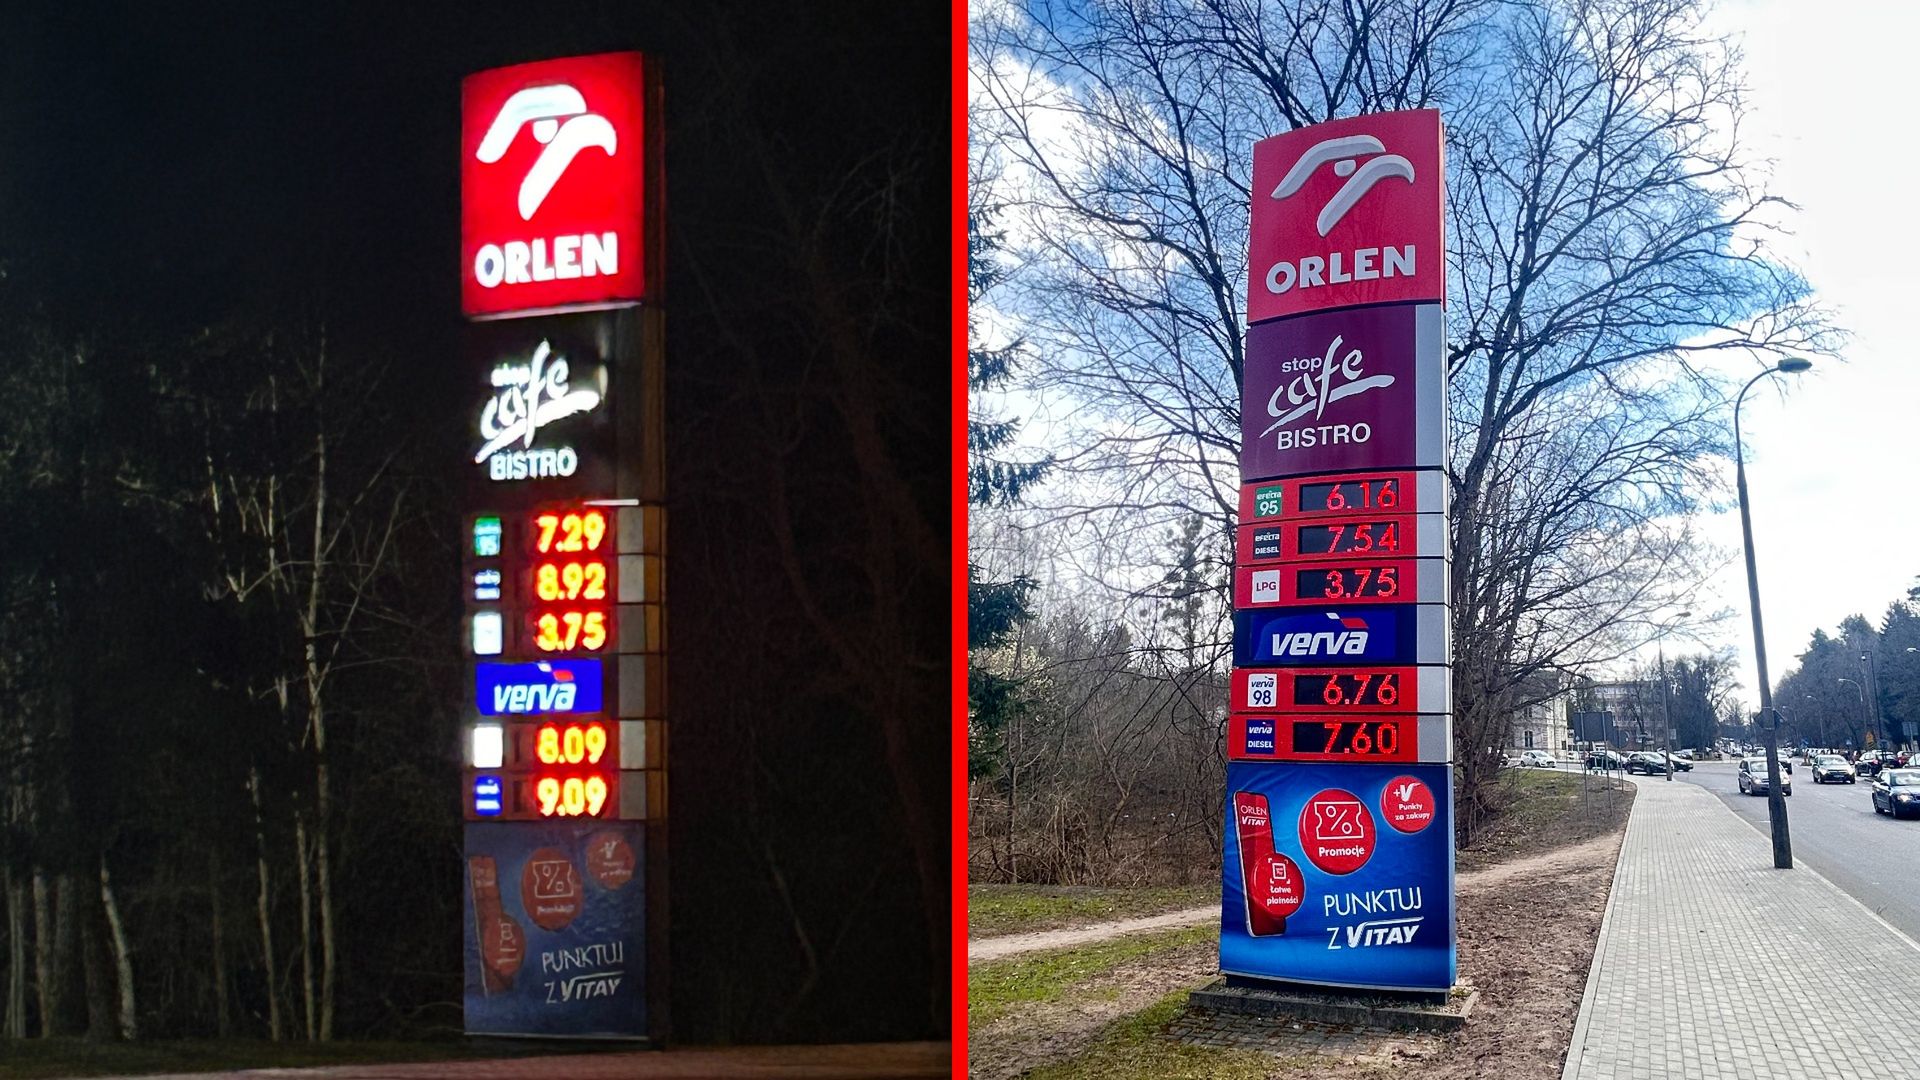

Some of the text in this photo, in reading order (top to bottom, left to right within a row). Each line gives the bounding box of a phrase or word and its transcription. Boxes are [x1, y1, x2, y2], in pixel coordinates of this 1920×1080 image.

[475, 231, 618, 288] ORLEN
[1265, 244, 1416, 295] ORLEN
[1281, 356, 1322, 373] stop
[1277, 422, 1372, 450] BISTRO
[490, 447, 578, 481] BISTRO
[1260, 500, 1278, 515] 95
[1327, 480, 1396, 511] 6.16
[538, 512, 606, 553] 7.29
[1327, 523, 1397, 553] 7.54
[1255, 546, 1279, 554] DIESEL
[1256, 582, 1277, 592] LPG
[1325, 568, 1397, 599] 3.75
[536, 611, 606, 650] 3.75
[1272, 631, 1369, 656] verva
[494, 684, 577, 712] verva
[1253, 690, 1272, 705] 98
[1323, 674, 1397, 705] 6.76
[1323, 723, 1396, 754] 7.60
[537, 775, 607, 816] 9.09
[1398, 803, 1423, 811] Punkty
[1240, 805, 1267, 816] ORLEN
[1405, 812, 1431, 820] zakupy
[1318, 846, 1365, 857] Promocje
[1266, 896, 1299, 907] płatności
[1269, 885, 1292, 894] Łatwe
[1324, 887, 1422, 917] PUNKTUJ
[1327, 927, 1341, 950] Z
[542, 941, 624, 974] PUNKTUJ
